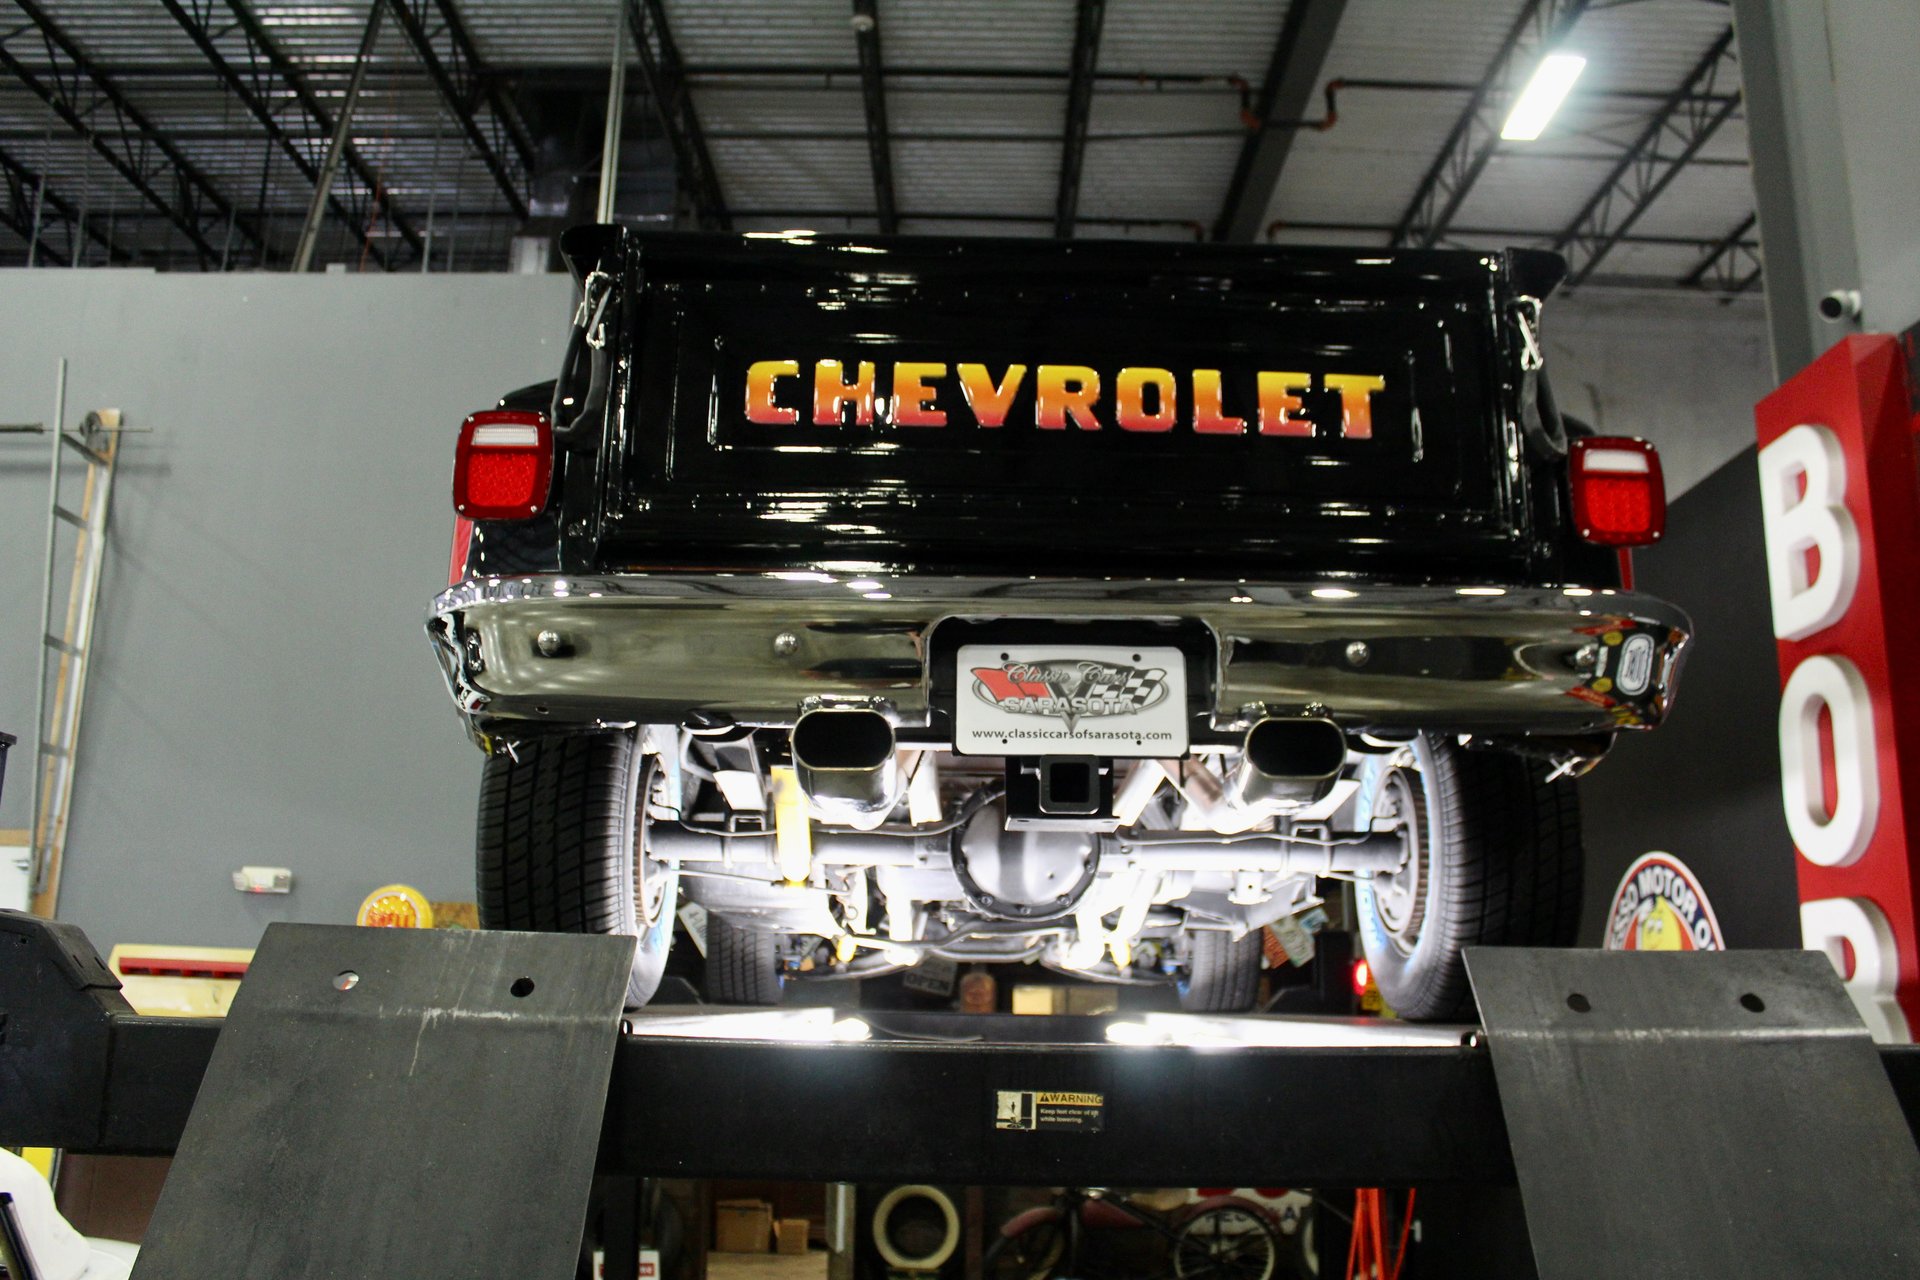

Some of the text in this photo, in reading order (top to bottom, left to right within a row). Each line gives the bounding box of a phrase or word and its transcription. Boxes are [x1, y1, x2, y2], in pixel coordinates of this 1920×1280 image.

[744, 360, 1386, 440] CHEVROLET
[1001, 661, 1130, 684] Classic Cars
[1003, 696, 1138, 716] SARASOTA
[972, 728, 1172, 741] www.classiccarsofsarasota.com
[1637, 865, 1698, 924] MOTOR
[1050, 1094, 1102, 1104] WARNING
